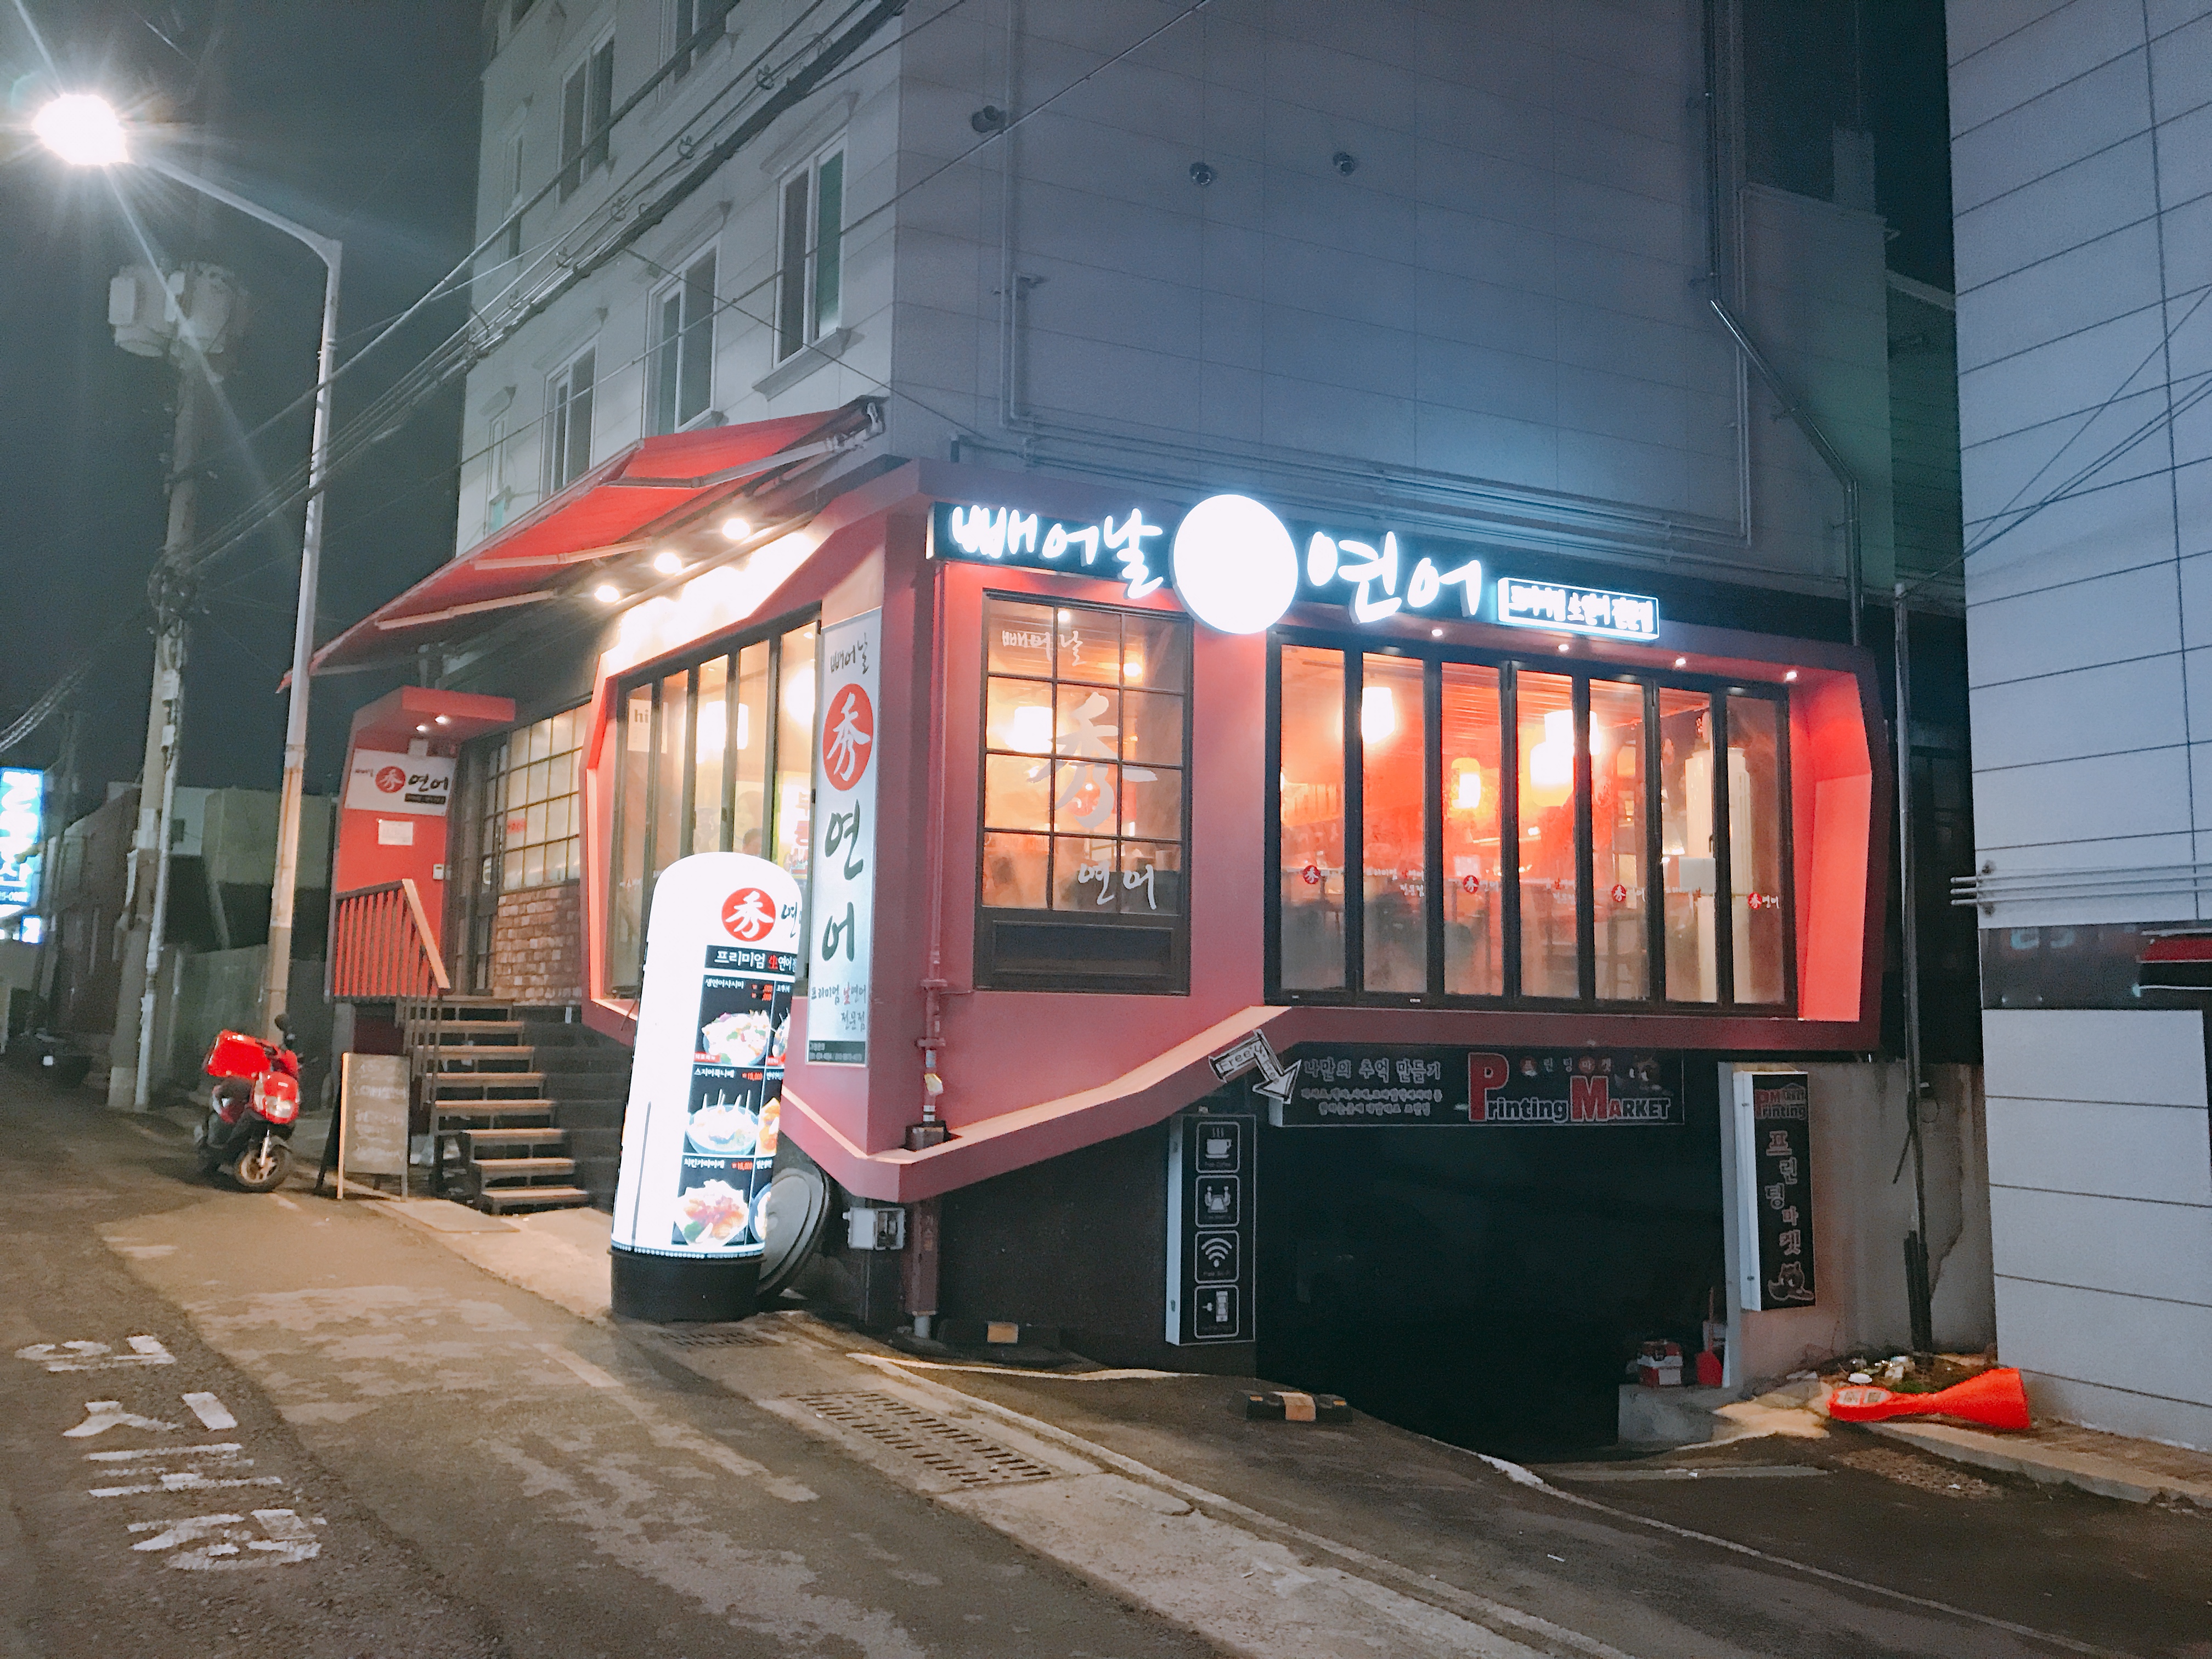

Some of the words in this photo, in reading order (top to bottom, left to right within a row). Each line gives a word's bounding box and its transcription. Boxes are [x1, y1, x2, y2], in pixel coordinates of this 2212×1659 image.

[952, 505, 1164, 599] 빼어날
[1307, 531, 1482, 624] 연어
[781, 901, 802, 939] 연
[714, 950, 766, 969] 프리미엄
[1304, 1056, 1352, 1082] 나만의
[1358, 1057, 1390, 1084] 추억
[1396, 1058, 1441, 1084] 만들기
[1468, 1052, 1570, 1124] Printing
